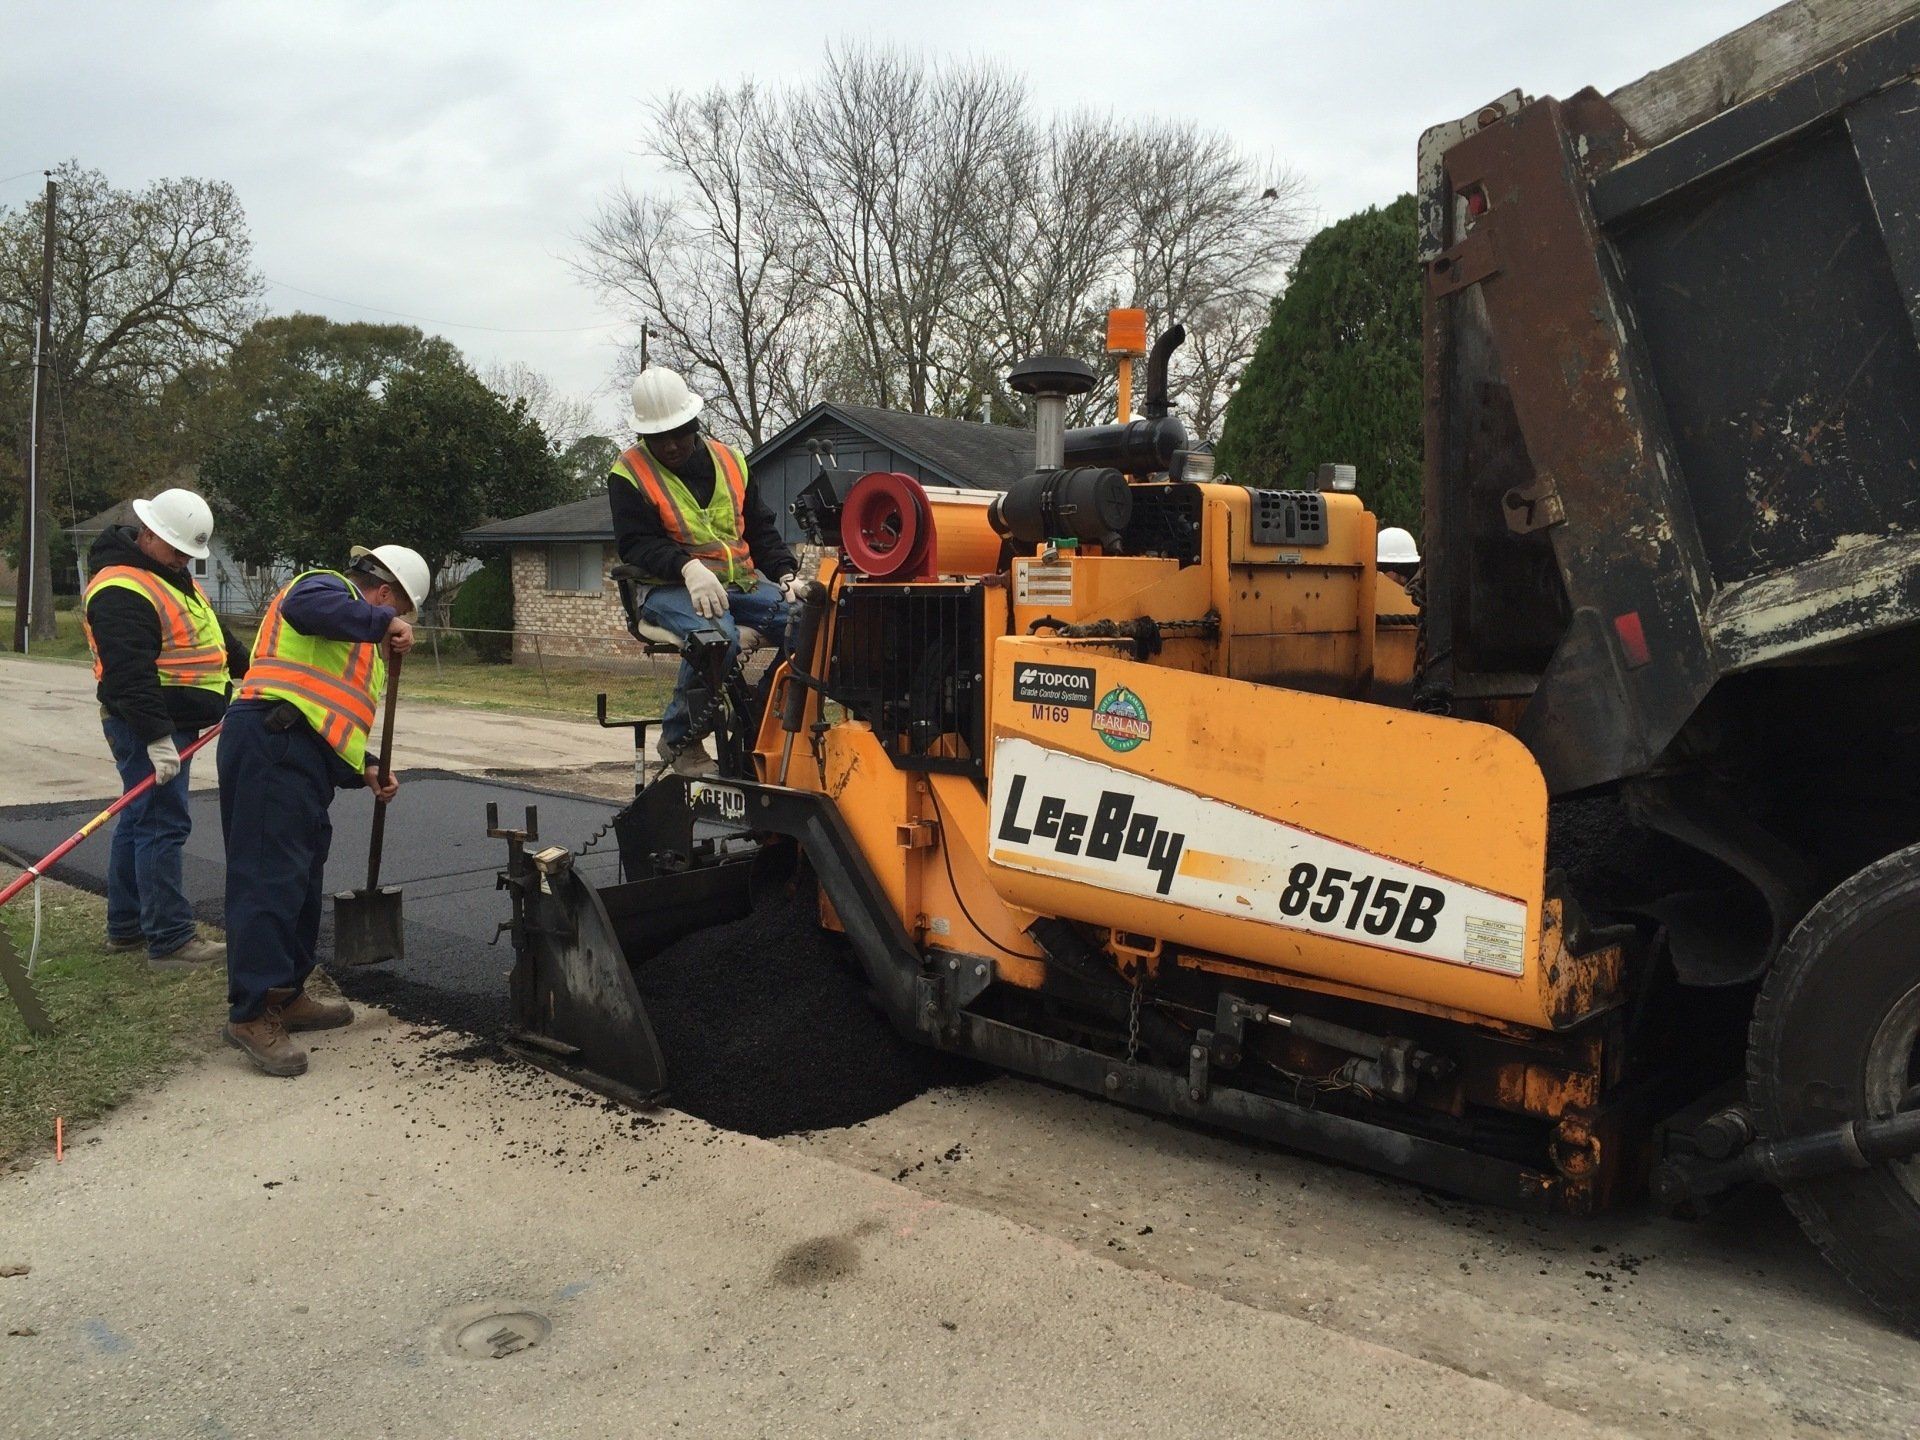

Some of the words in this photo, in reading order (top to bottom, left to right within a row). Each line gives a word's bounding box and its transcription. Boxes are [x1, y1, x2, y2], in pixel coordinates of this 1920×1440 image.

[1038, 671, 1090, 689] TOPCON
[1020, 686, 1038, 697] Grade
[1039, 688, 1060, 699] Control
[1061, 690, 1088, 702] Systems
[1032, 704, 1069, 723] M169
[1094, 713, 1150, 734] PEARLAND
[686, 781, 744, 811] LGEND
[998, 774, 1185, 895] LeeBoy
[1279, 862, 1446, 943] 8515B
[1482, 920, 1506, 929] CAUTION
